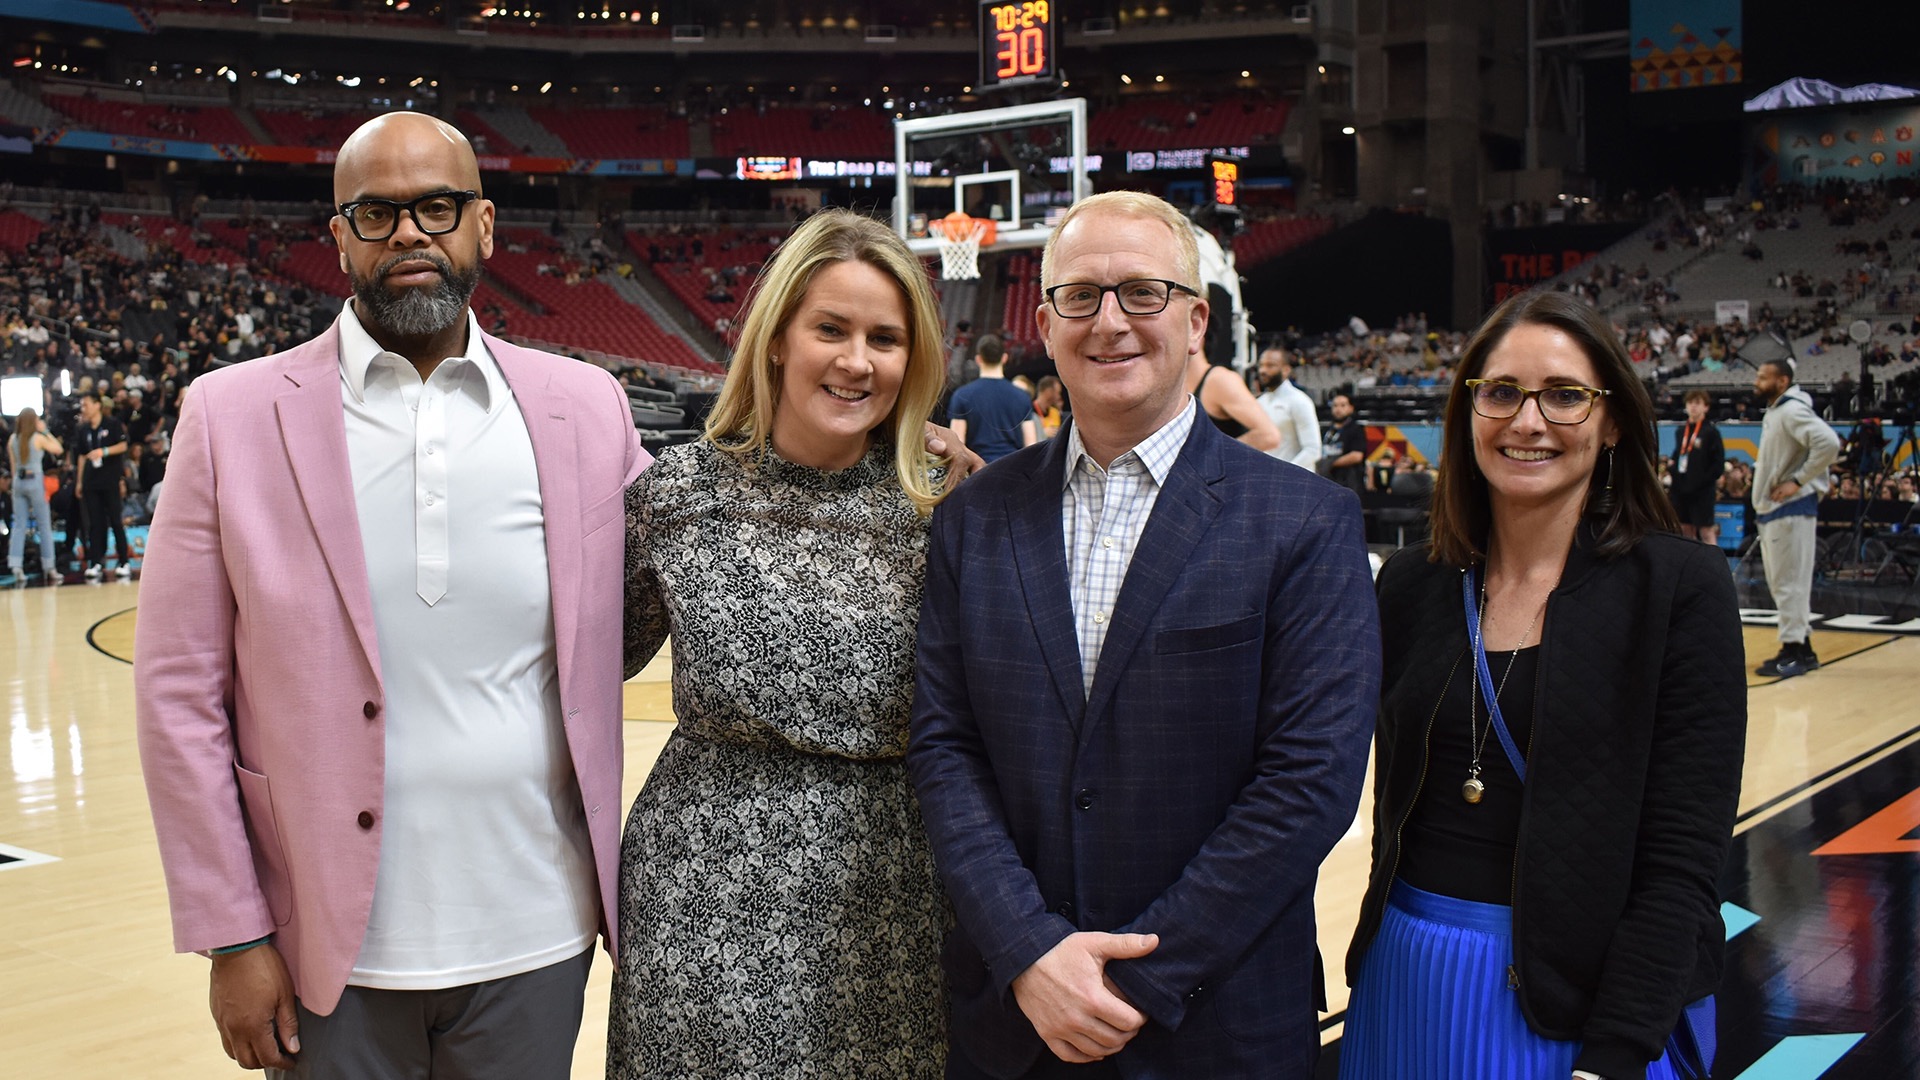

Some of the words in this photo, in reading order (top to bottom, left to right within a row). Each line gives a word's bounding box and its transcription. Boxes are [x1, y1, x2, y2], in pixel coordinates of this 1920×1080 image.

[996, 27, 1044, 79] 30
[808, 160, 836, 176] THE
[837, 160, 875, 176] ROAD
[876, 161, 912, 176] ENS
[1501, 253, 1556, 279] THE
